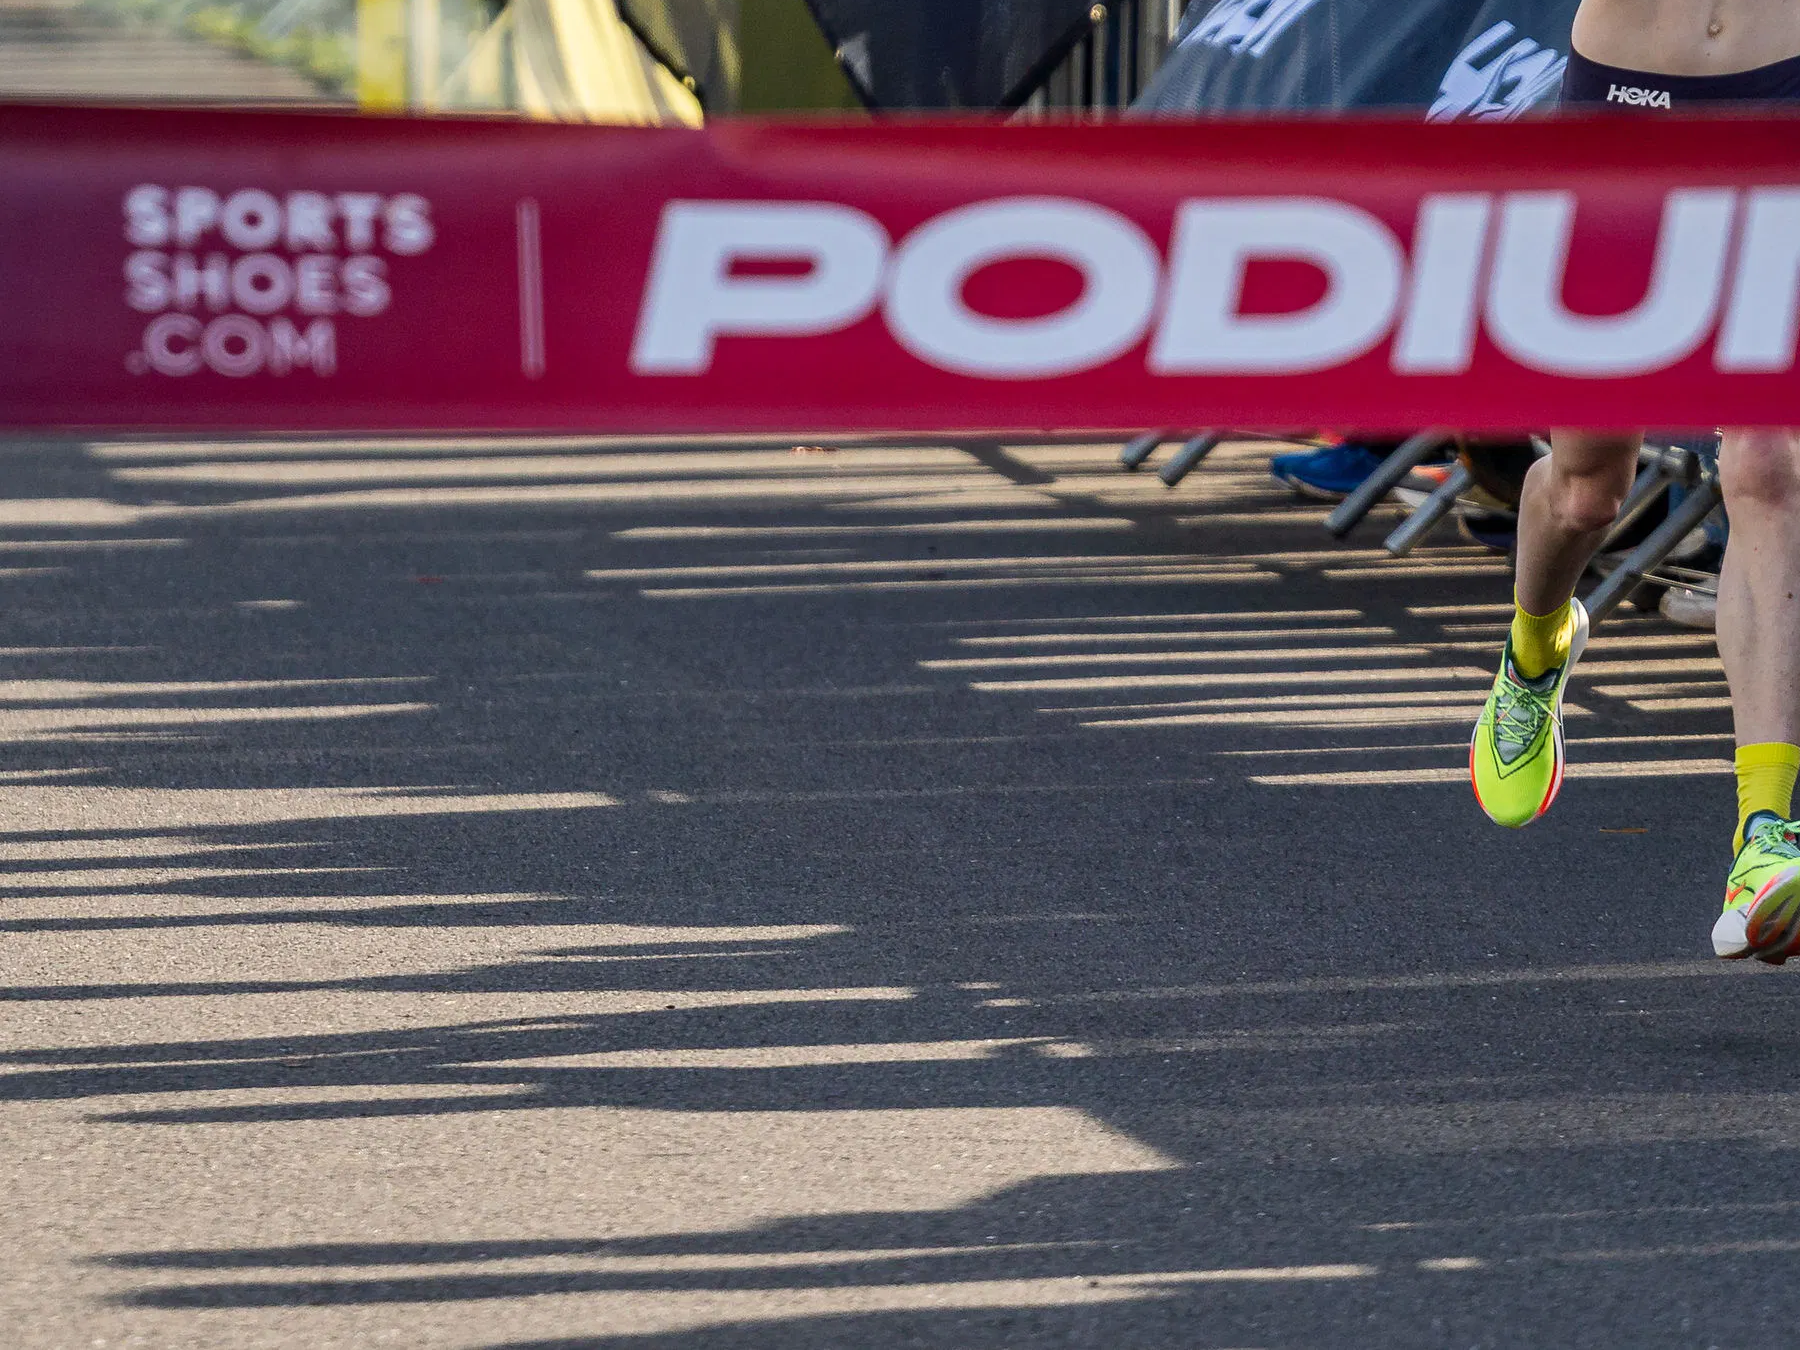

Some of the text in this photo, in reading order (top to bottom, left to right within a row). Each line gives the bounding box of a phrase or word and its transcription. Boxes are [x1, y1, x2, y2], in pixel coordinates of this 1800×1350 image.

[1606, 84, 1671, 109] HOKA
[123, 184, 435, 256] SPORTS
[123, 250, 391, 317] SHOES
[124, 312, 338, 378] .COM
